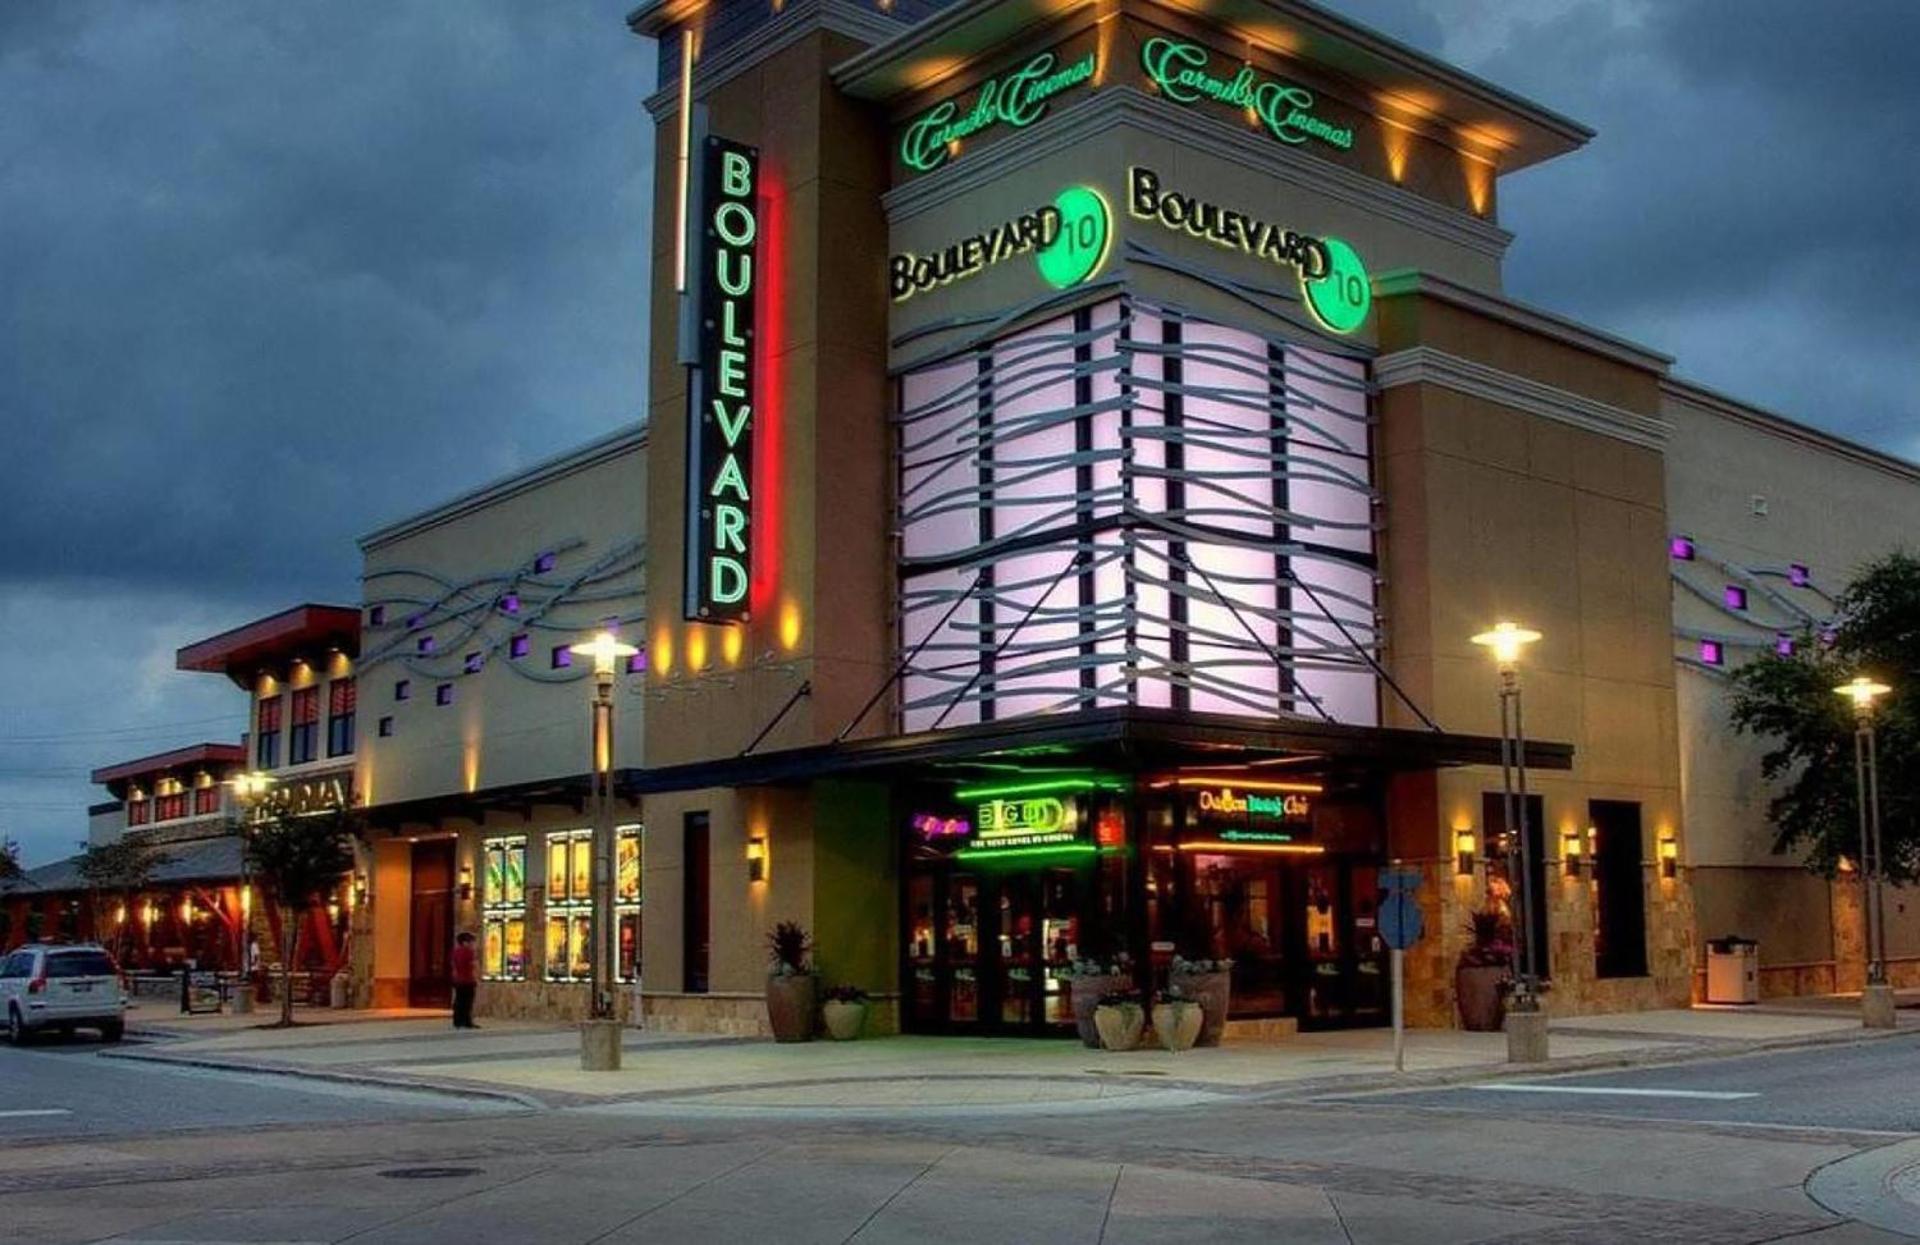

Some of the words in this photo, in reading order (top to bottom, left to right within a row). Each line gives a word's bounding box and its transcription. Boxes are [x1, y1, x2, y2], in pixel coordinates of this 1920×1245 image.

[998, 53, 1095, 127] Cinemas
[1144, 37, 1255, 101] Carmike
[1256, 83, 1354, 148] Cinemas
[889, 206, 1064, 302] BOULEVARD
[1064, 214, 1097, 257] 10
[1129, 165, 1333, 281] BOULEVARD
[1334, 269, 1364, 307] 10
[711, 150, 757, 606] BOULEVARD
